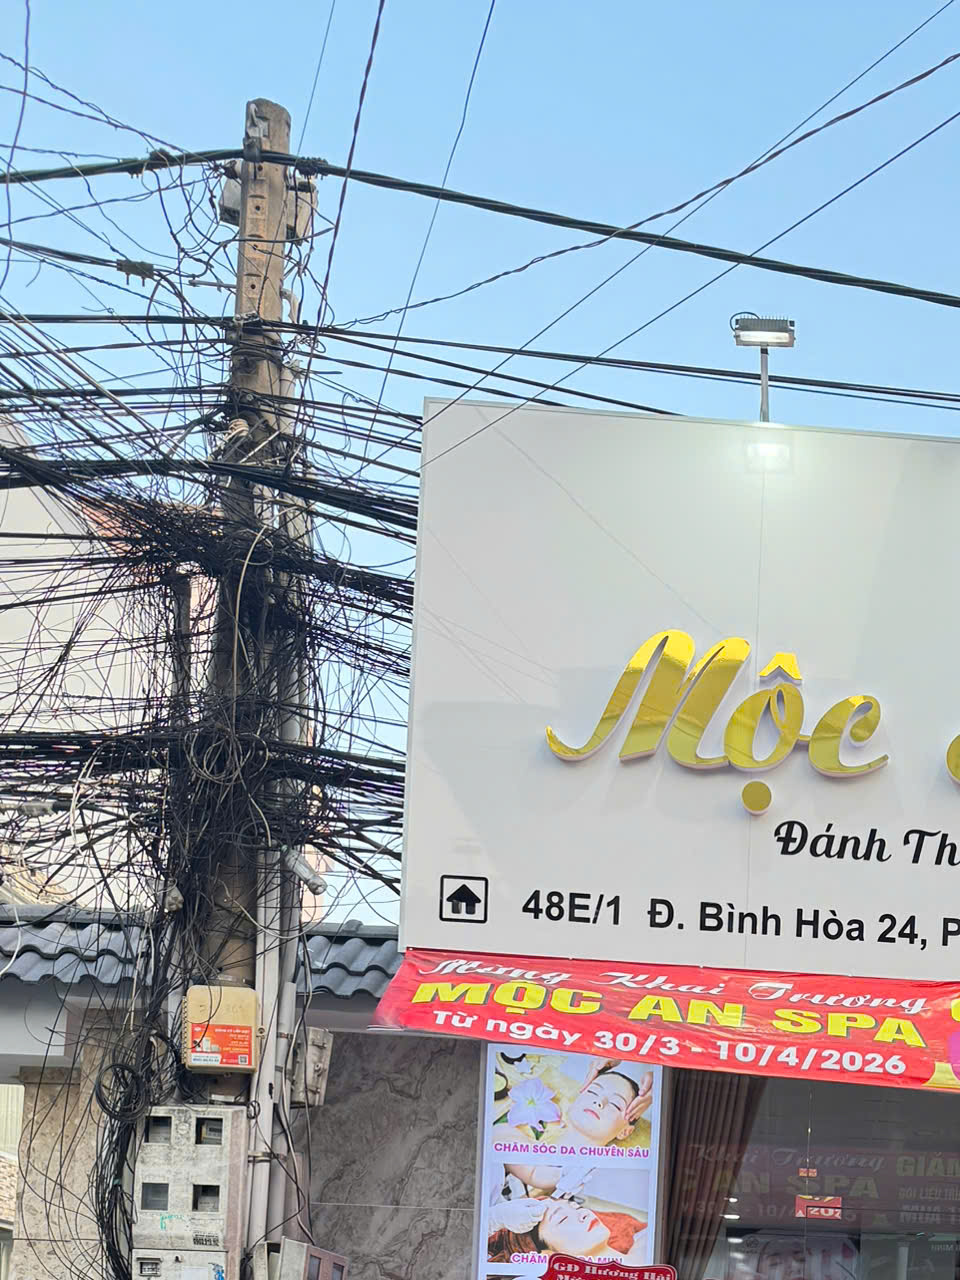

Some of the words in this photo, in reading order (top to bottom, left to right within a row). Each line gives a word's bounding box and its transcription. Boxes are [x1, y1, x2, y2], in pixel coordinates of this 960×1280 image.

[544, 629, 889, 816] Mộc
[773, 820, 892, 863] Đánh
[521, 889, 622, 926] 48E/1
[647, 897, 686, 932] Đ.
[699, 900, 782, 937] Bình
[811, 907, 866, 943] Hòa
[876, 915, 928, 951] 24,
[418, 958, 575, 985] Mừng
[589, 971, 729, 996] Khai
[411, 979, 603, 1014] MỘC
[628, 995, 745, 1028] AN
[772, 1009, 928, 1049] SPA
[432, 1010, 476, 1029] Từ
[486, 1018, 582, 1047] ngày
[593, 1031, 681, 1056] 30/3
[716, 1039, 907, 1076] 10/4/2026
[494, 1141, 529, 1153] CHĂM
[532, 1142, 557, 1154] SÓC
[560, 1146, 577, 1155] DA
[579, 1145, 626, 1157] CHUYÊN
[627, 1146, 649, 1158] SÂU
[511, 1252, 547, 1264] CHĂM
[584, 1265, 639, 1280] Hương
